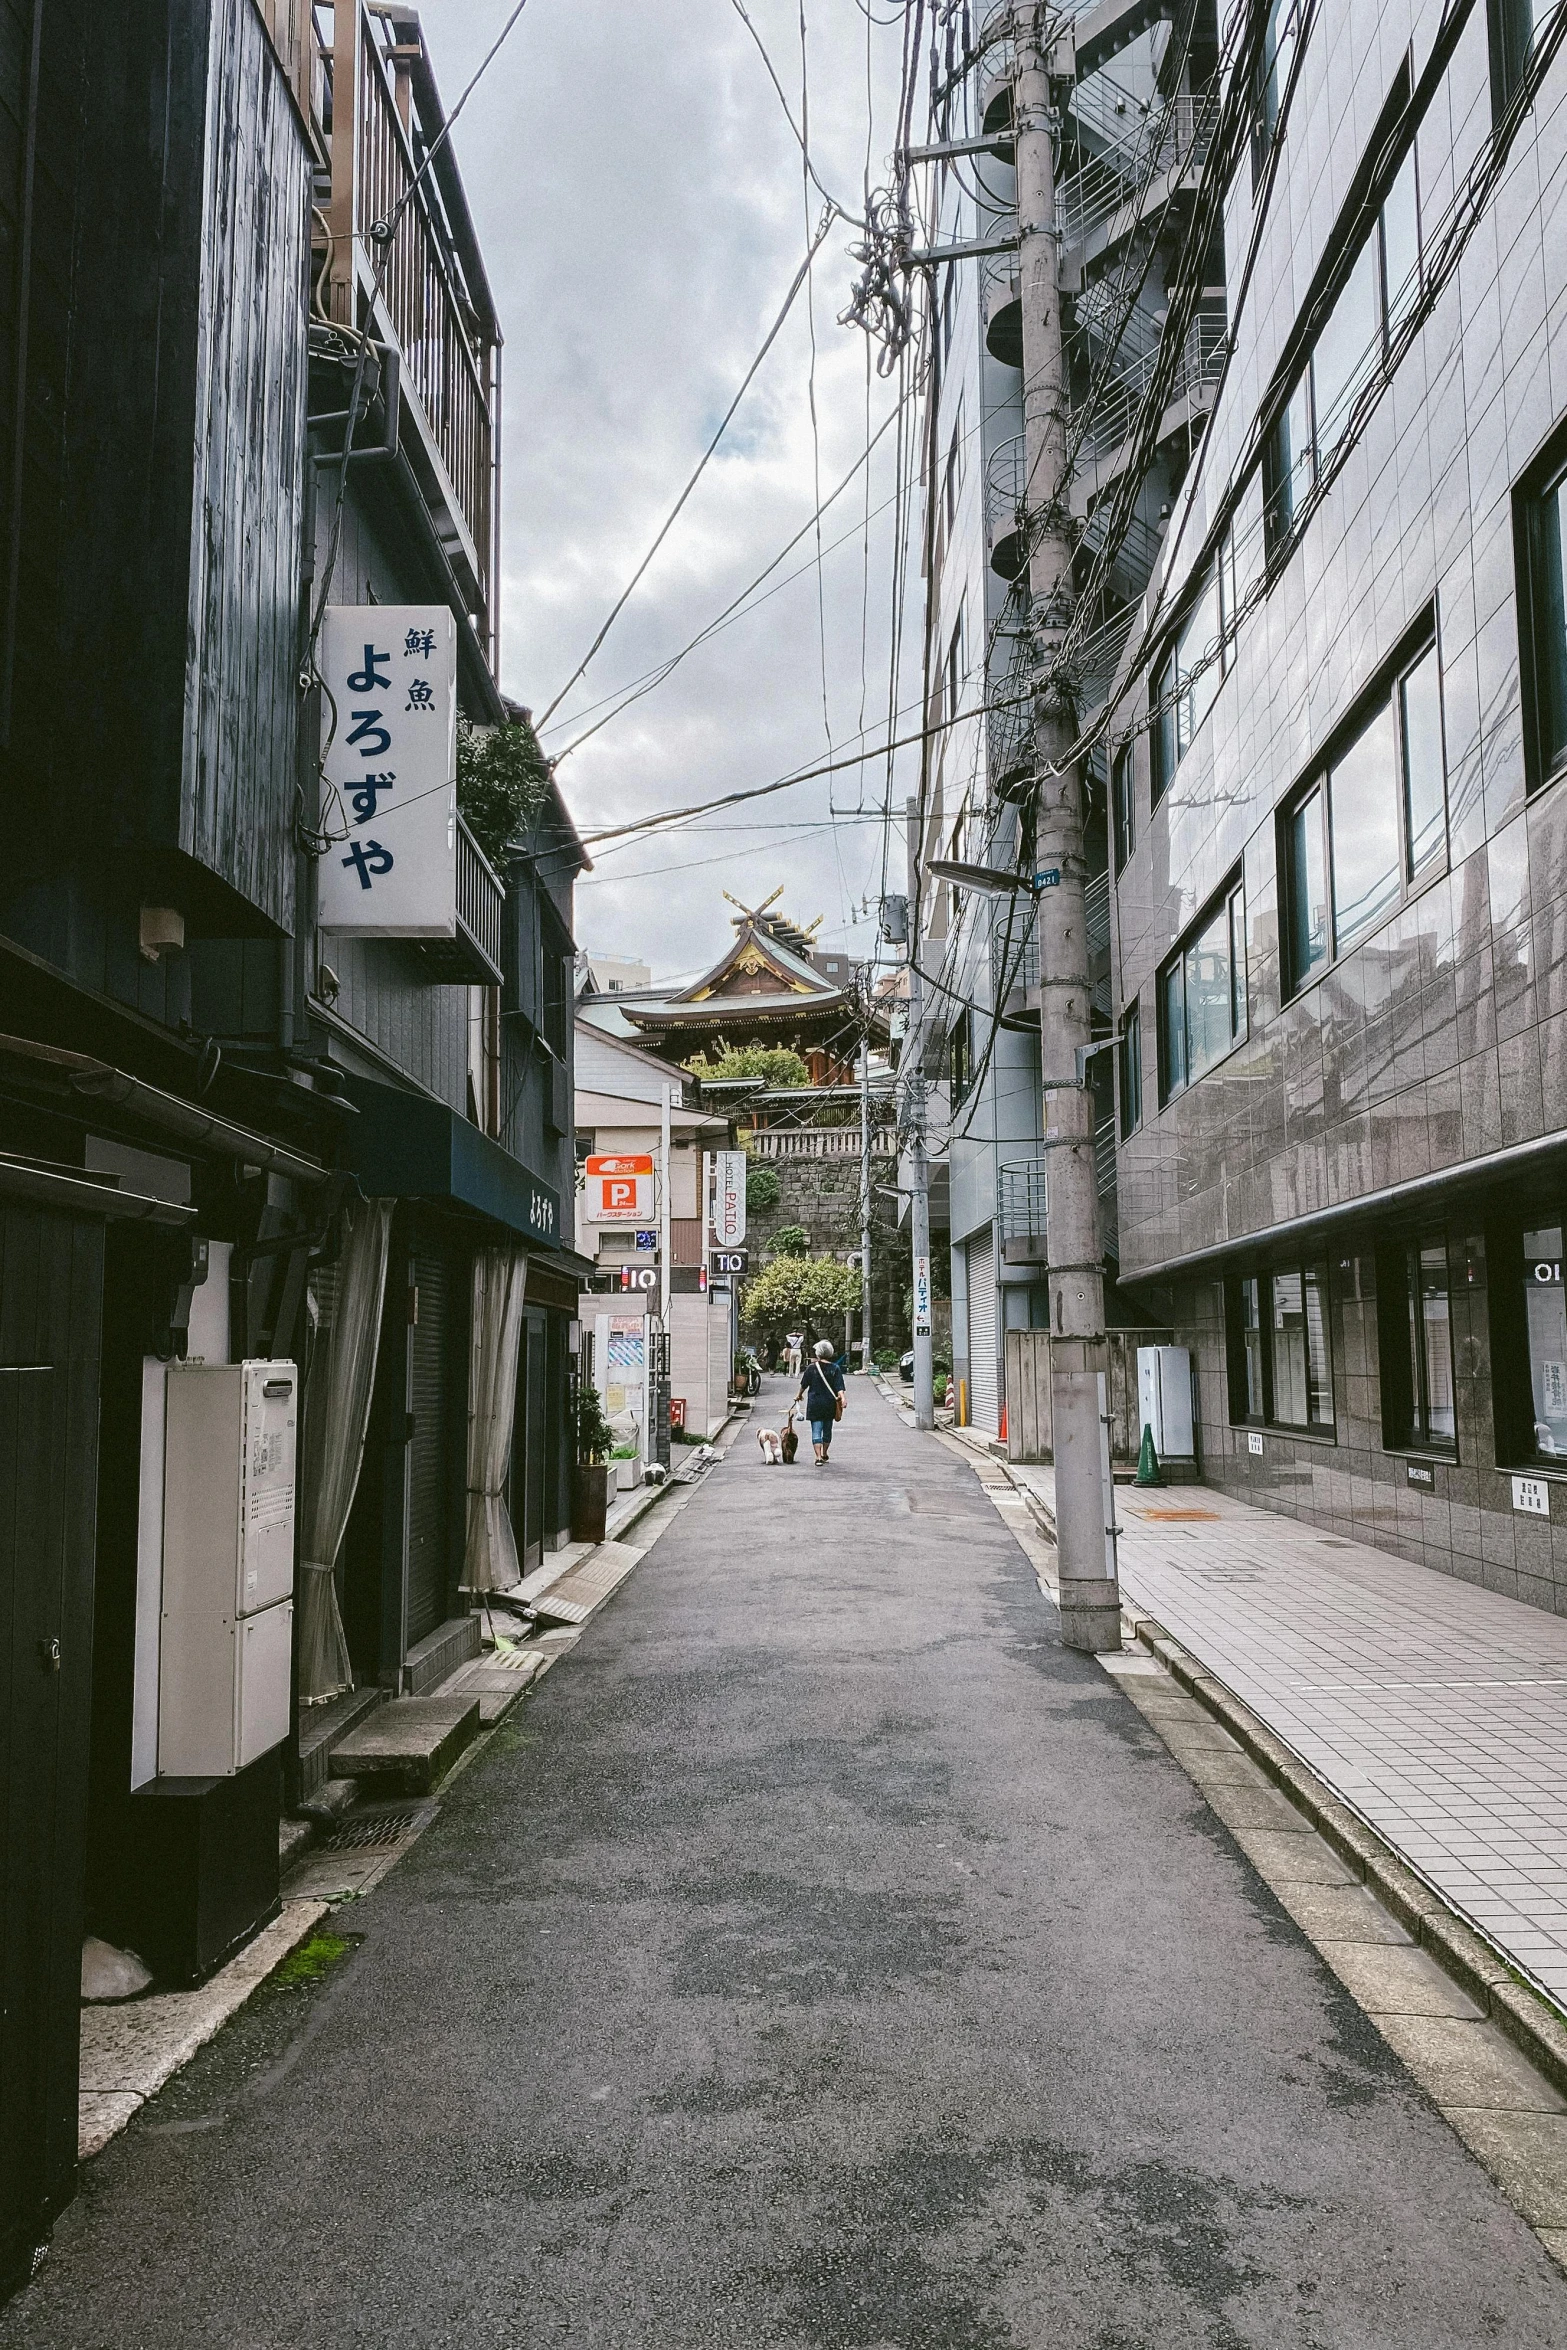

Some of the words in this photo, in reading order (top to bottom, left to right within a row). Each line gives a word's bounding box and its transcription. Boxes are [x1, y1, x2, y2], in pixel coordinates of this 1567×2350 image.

[403, 628, 437, 712] 鮮魚
[341, 644, 396, 890] よろずや
[611, 1183, 630, 1207] P
[726, 1162, 734, 1191] HOTEL
[530, 1189, 553, 1234] よろずや
[596, 1210, 643, 1218] パークステーション
[725, 1192, 737, 1235] PATIO
